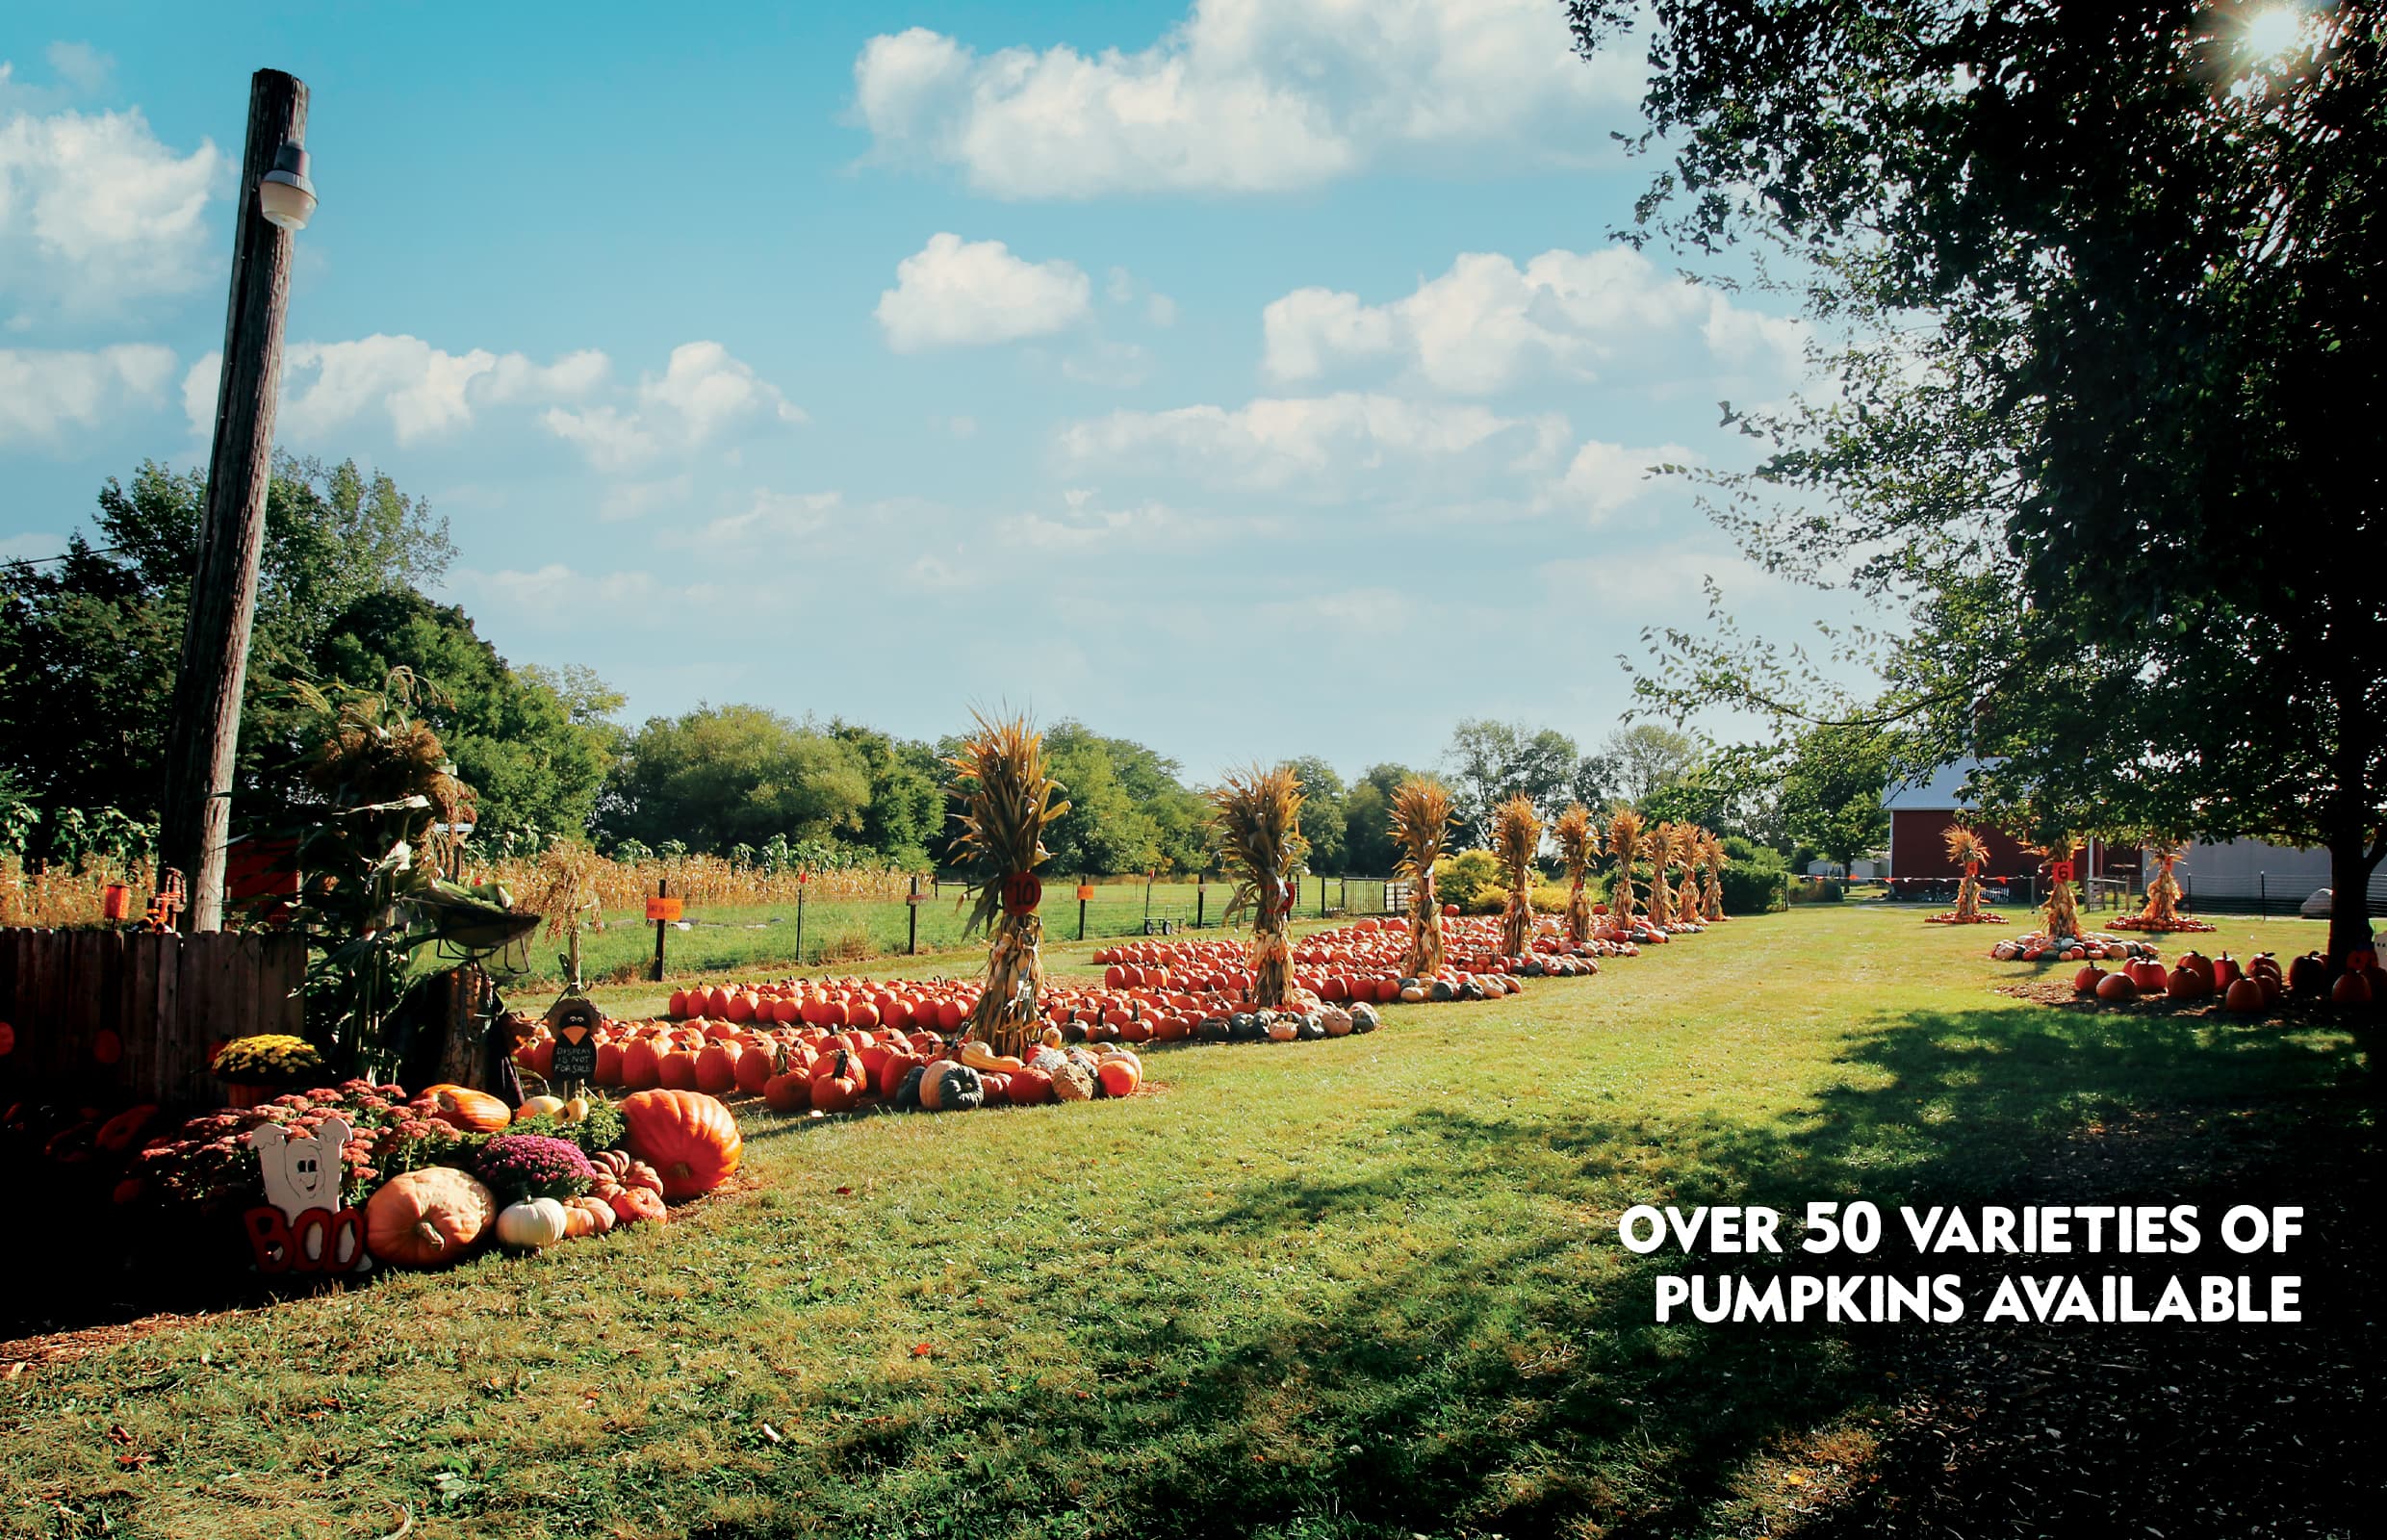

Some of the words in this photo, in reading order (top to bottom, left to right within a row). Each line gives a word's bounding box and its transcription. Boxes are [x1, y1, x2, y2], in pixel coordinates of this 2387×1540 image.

[2058, 865, 2068, 879] 6
[1015, 880, 1036, 906] 10
[556, 1046, 591, 1057] DISPLAY
[558, 1056, 568, 1065] IS
[554, 1064, 571, 1072] FOR
[572, 1064, 591, 1074] SALE
[244, 1204, 364, 1273] BOO
